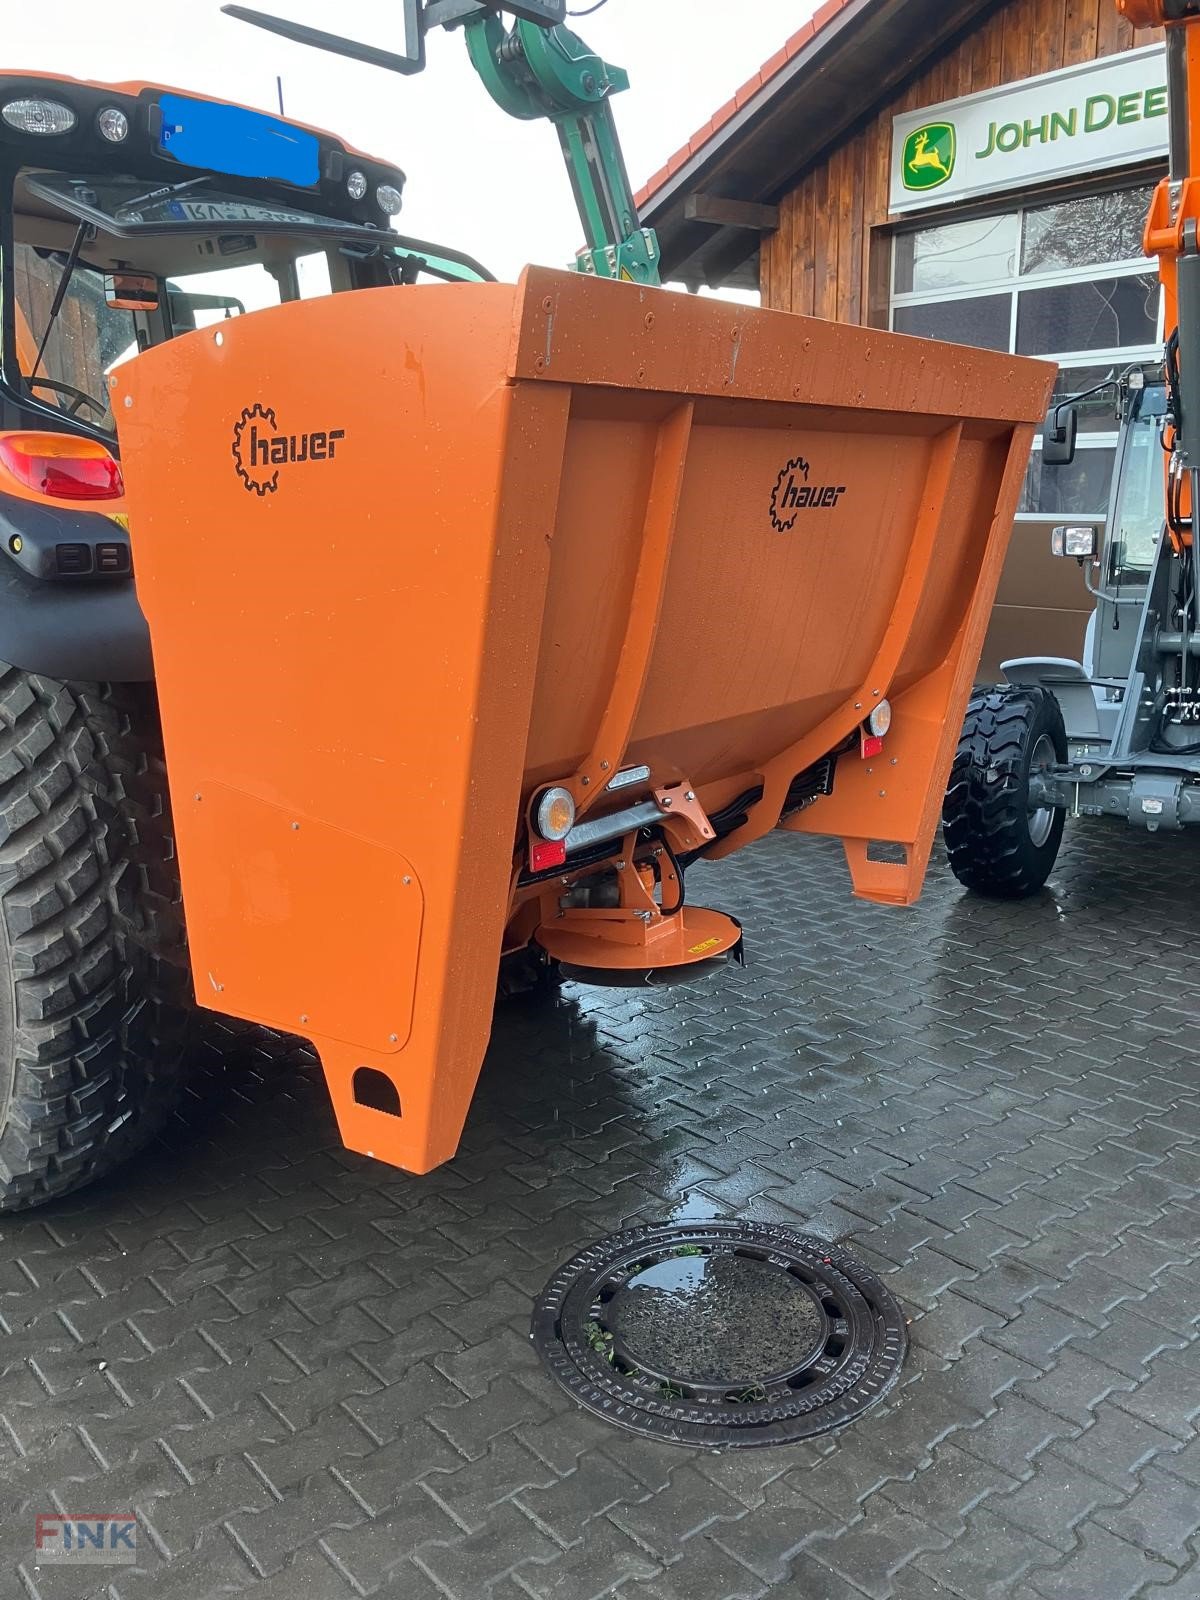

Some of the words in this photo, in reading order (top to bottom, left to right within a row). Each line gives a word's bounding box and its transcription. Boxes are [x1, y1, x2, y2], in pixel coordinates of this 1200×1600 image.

[164, 131, 171, 140] D
[975, 108, 1077, 159] JOHN
[250, 426, 345, 466] hauer
[780, 474, 847, 508] hauer
